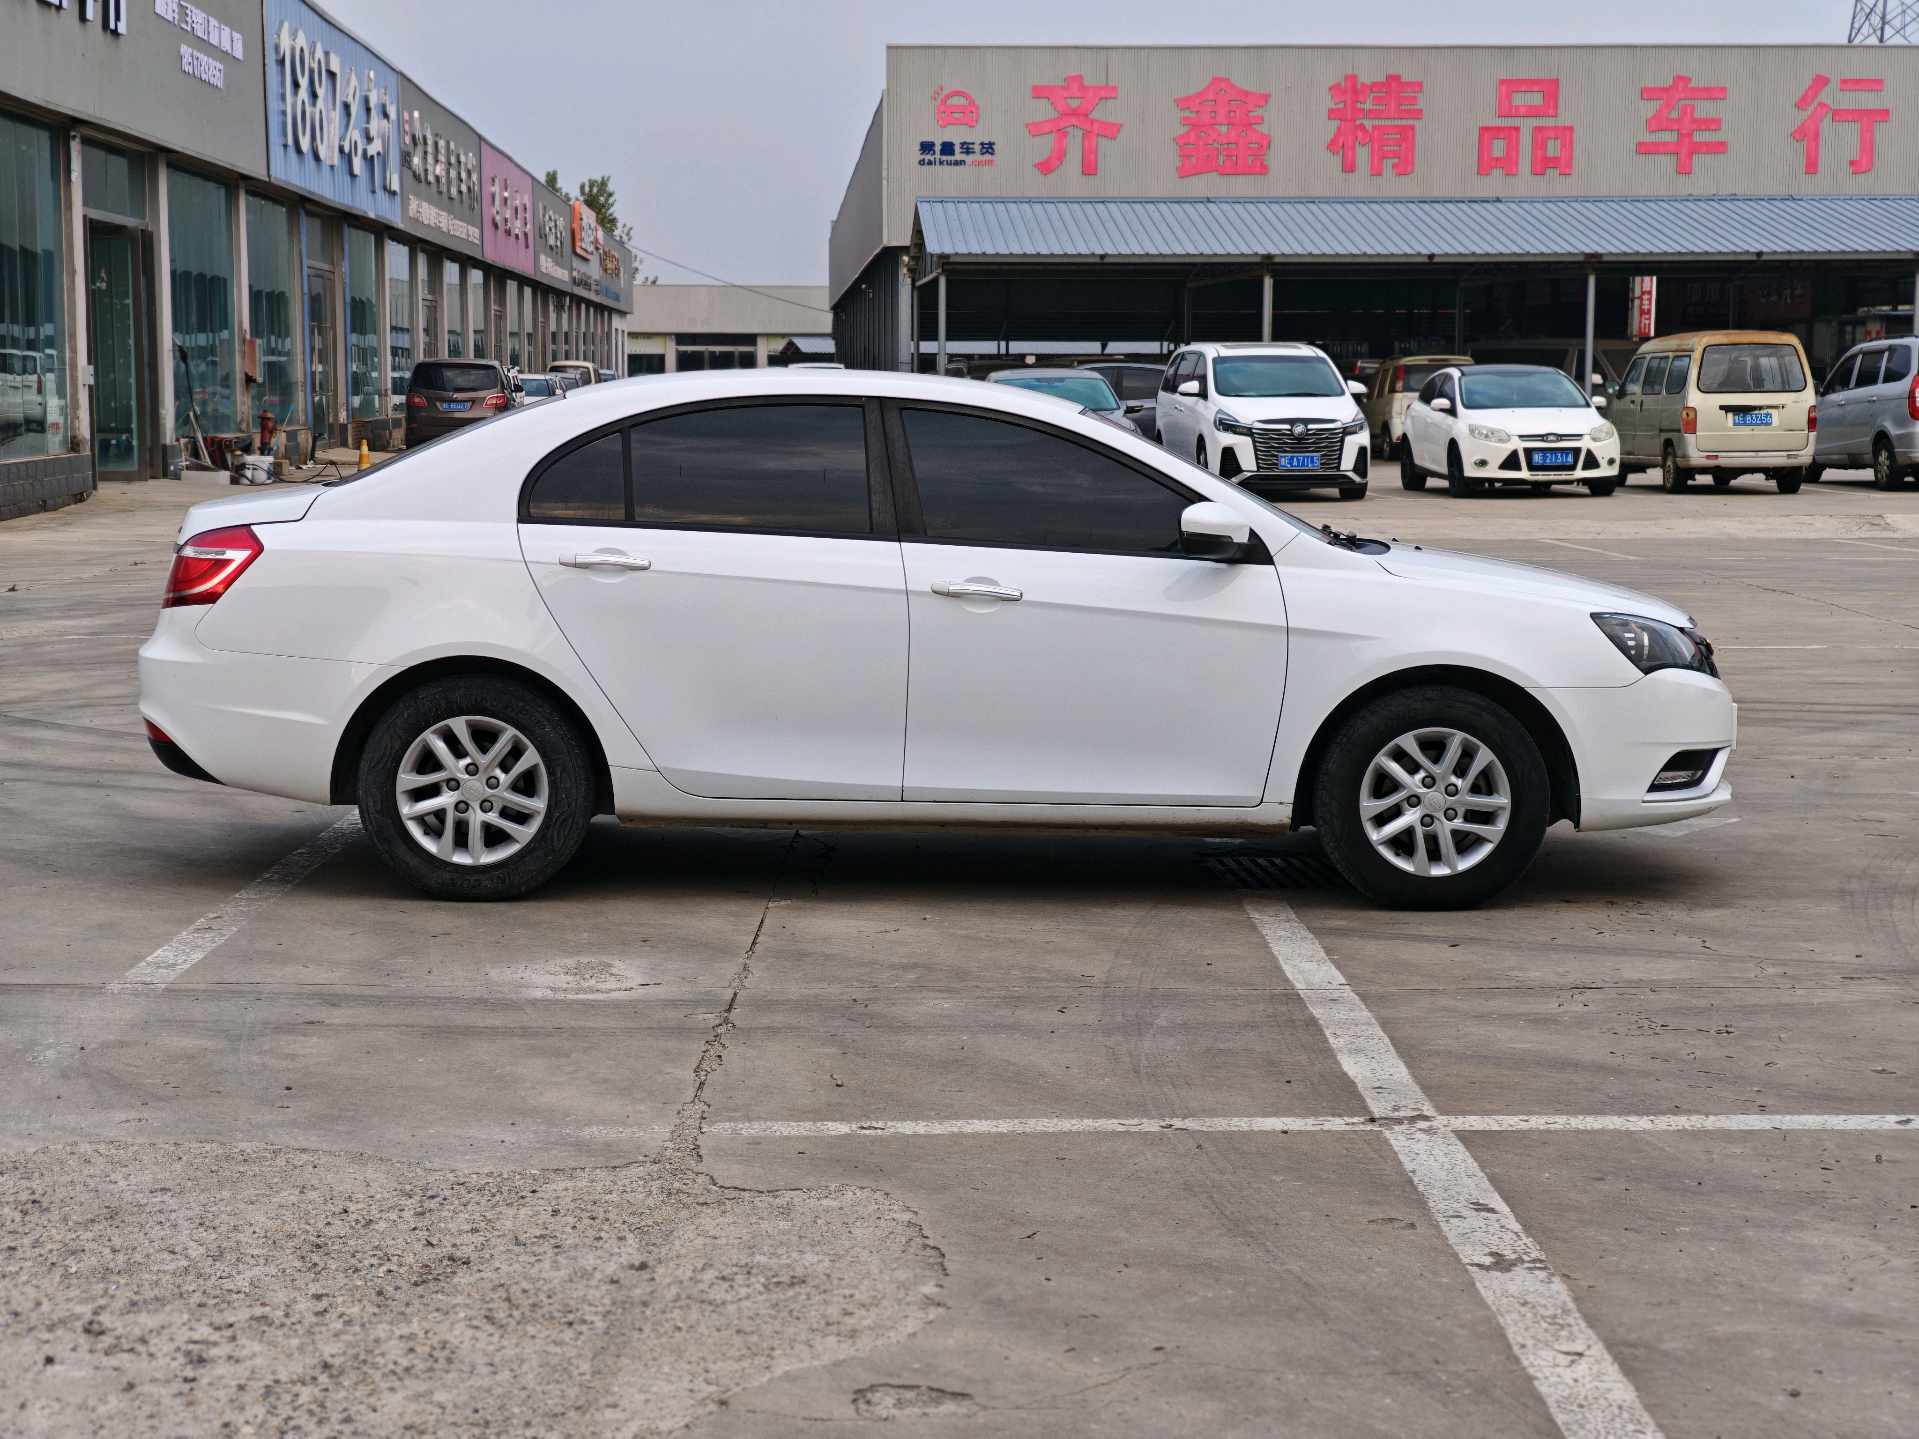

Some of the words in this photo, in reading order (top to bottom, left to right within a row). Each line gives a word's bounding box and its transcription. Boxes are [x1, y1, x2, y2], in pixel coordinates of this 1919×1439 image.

[1026, 74, 1890, 178] 齐鑫精品车行
